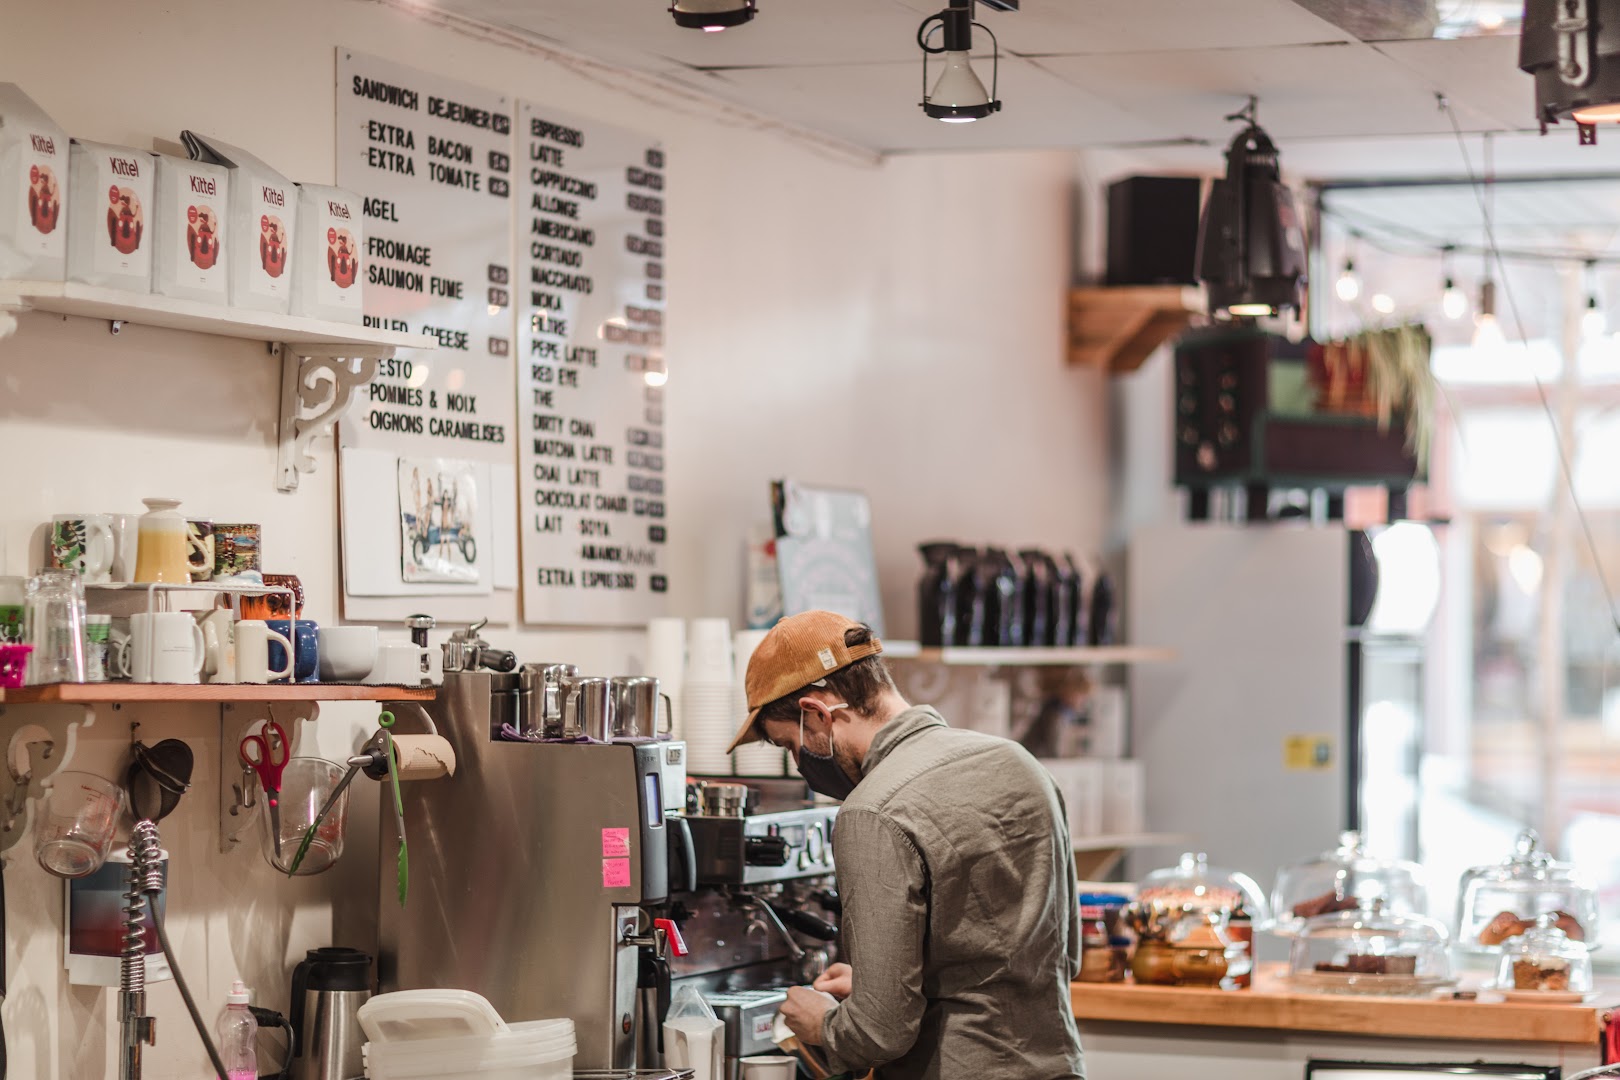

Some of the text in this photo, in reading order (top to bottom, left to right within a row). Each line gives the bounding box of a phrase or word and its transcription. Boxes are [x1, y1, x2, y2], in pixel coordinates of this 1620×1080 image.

[353, 75, 419, 111] SANDWICH
[428, 96, 491, 130] DEJEUNER
[30, 133, 55, 155] Kittel
[368, 120, 415, 150] EXTRA
[428, 135, 473, 164] BACON
[530, 142, 564, 168] LATTE
[110, 157, 139, 177] Kittel
[368, 147, 415, 176] EXTRA
[428, 161, 480, 192] TOMATE
[190, 175, 216, 196] Kittel
[262, 186, 285, 207] Kittel
[327, 201, 351, 220] Kittel
[363, 196, 399, 222] AGEL
[532, 192, 579, 220] ALLONGE
[368, 237, 431, 267] FROMAGE
[369, 265, 423, 293] SAUMON
[430, 276, 464, 300] FUME
[565, 345, 597, 368] LATTE
[379, 358, 412, 379] ESTO
[370, 383, 476, 414] POMMES & NOIX
[533, 389, 552, 408] THE
[370, 410, 505, 443] OIGNONS CARAMELISES
[533, 413, 563, 433] DIRTY
[534, 438, 575, 459] MATCHA
[582, 446, 613, 465] LATTE
[534, 464, 599, 488] CHAI LATTE
[535, 490, 591, 509] CHOCOLAT
[536, 515, 562, 533] LAIT
[538, 568, 574, 588] EXTRA
